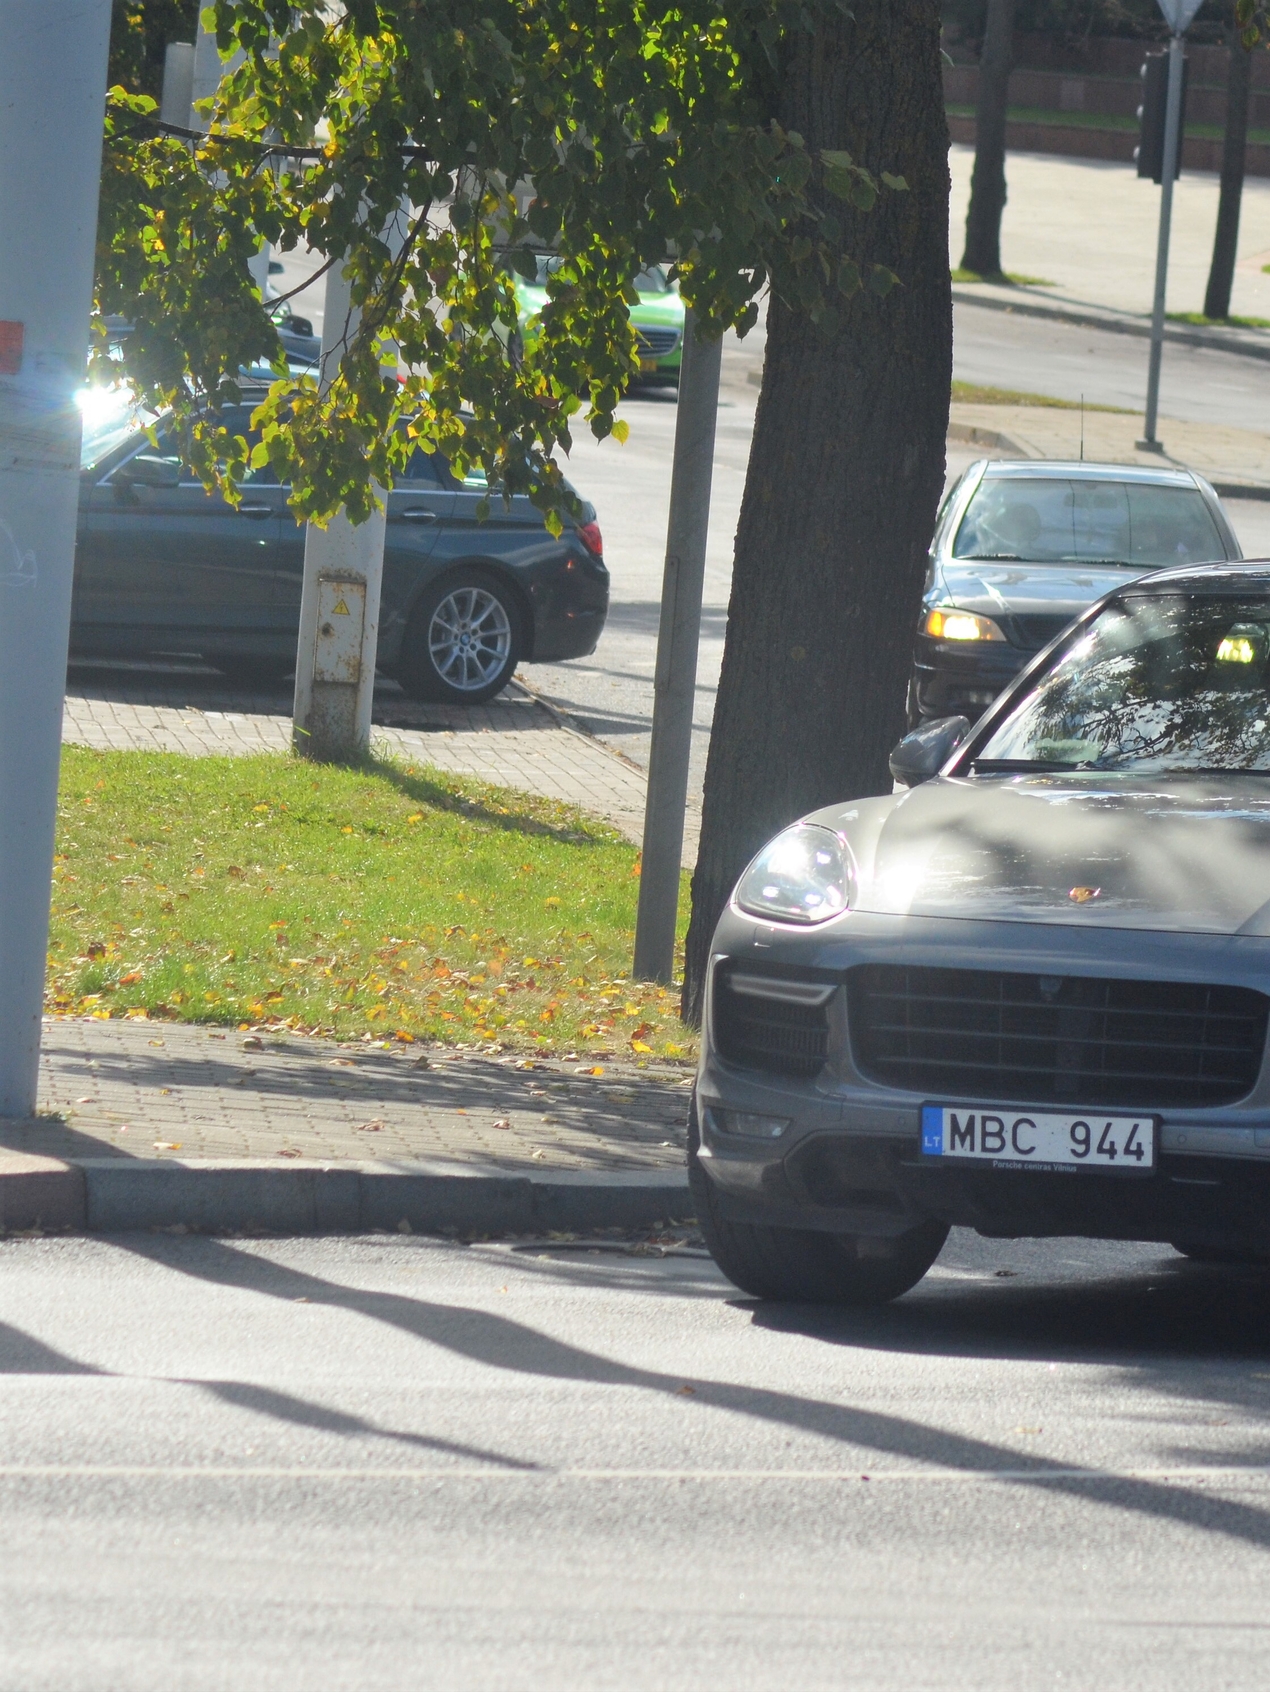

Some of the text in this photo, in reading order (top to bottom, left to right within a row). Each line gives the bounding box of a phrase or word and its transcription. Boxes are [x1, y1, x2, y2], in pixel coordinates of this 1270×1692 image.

[924, 1136, 941, 1148] LT
[950, 1113, 1145, 1161] MBC 944
[992, 1160, 1022, 1169] Porsche
[1053, 1163, 1077, 1172] Vilnius
